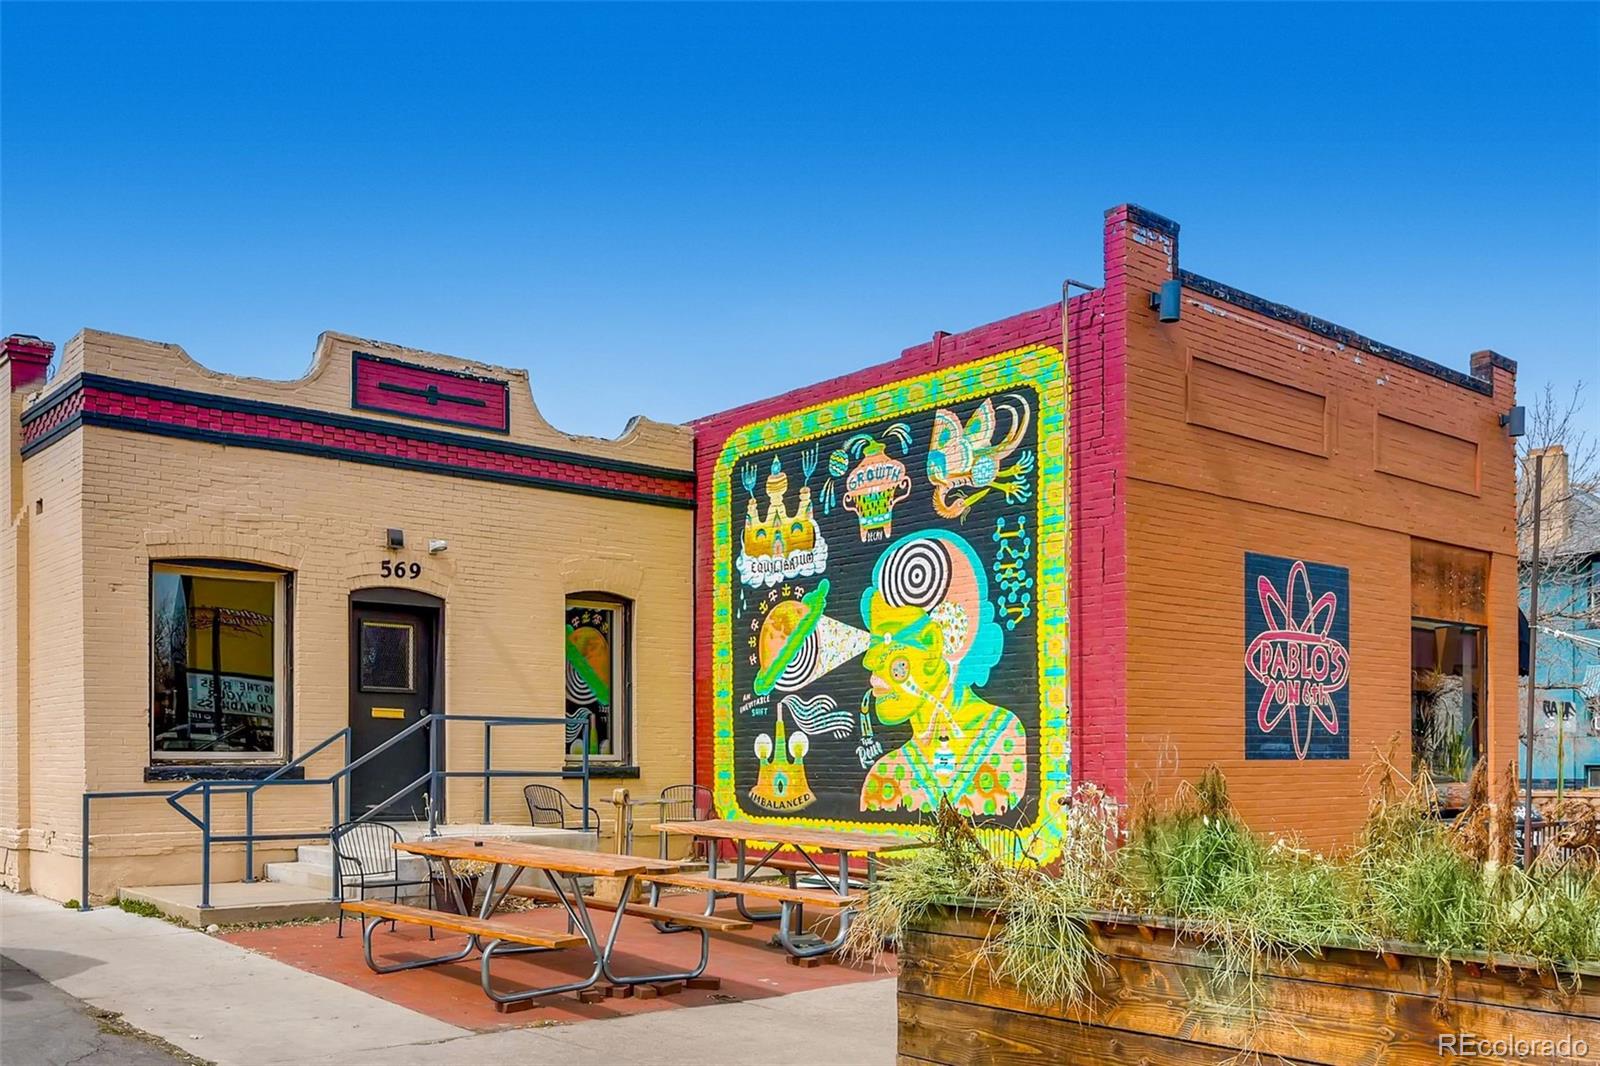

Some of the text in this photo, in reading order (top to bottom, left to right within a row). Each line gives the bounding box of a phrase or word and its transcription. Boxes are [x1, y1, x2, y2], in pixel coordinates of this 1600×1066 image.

[849, 464, 900, 489] GROWTH
[381, 560, 421, 579] 569
[1260, 641, 1343, 683] PABLO'S
[1276, 681, 1329, 706] ON 6th
[750, 792, 811, 809] IMBALANCED
